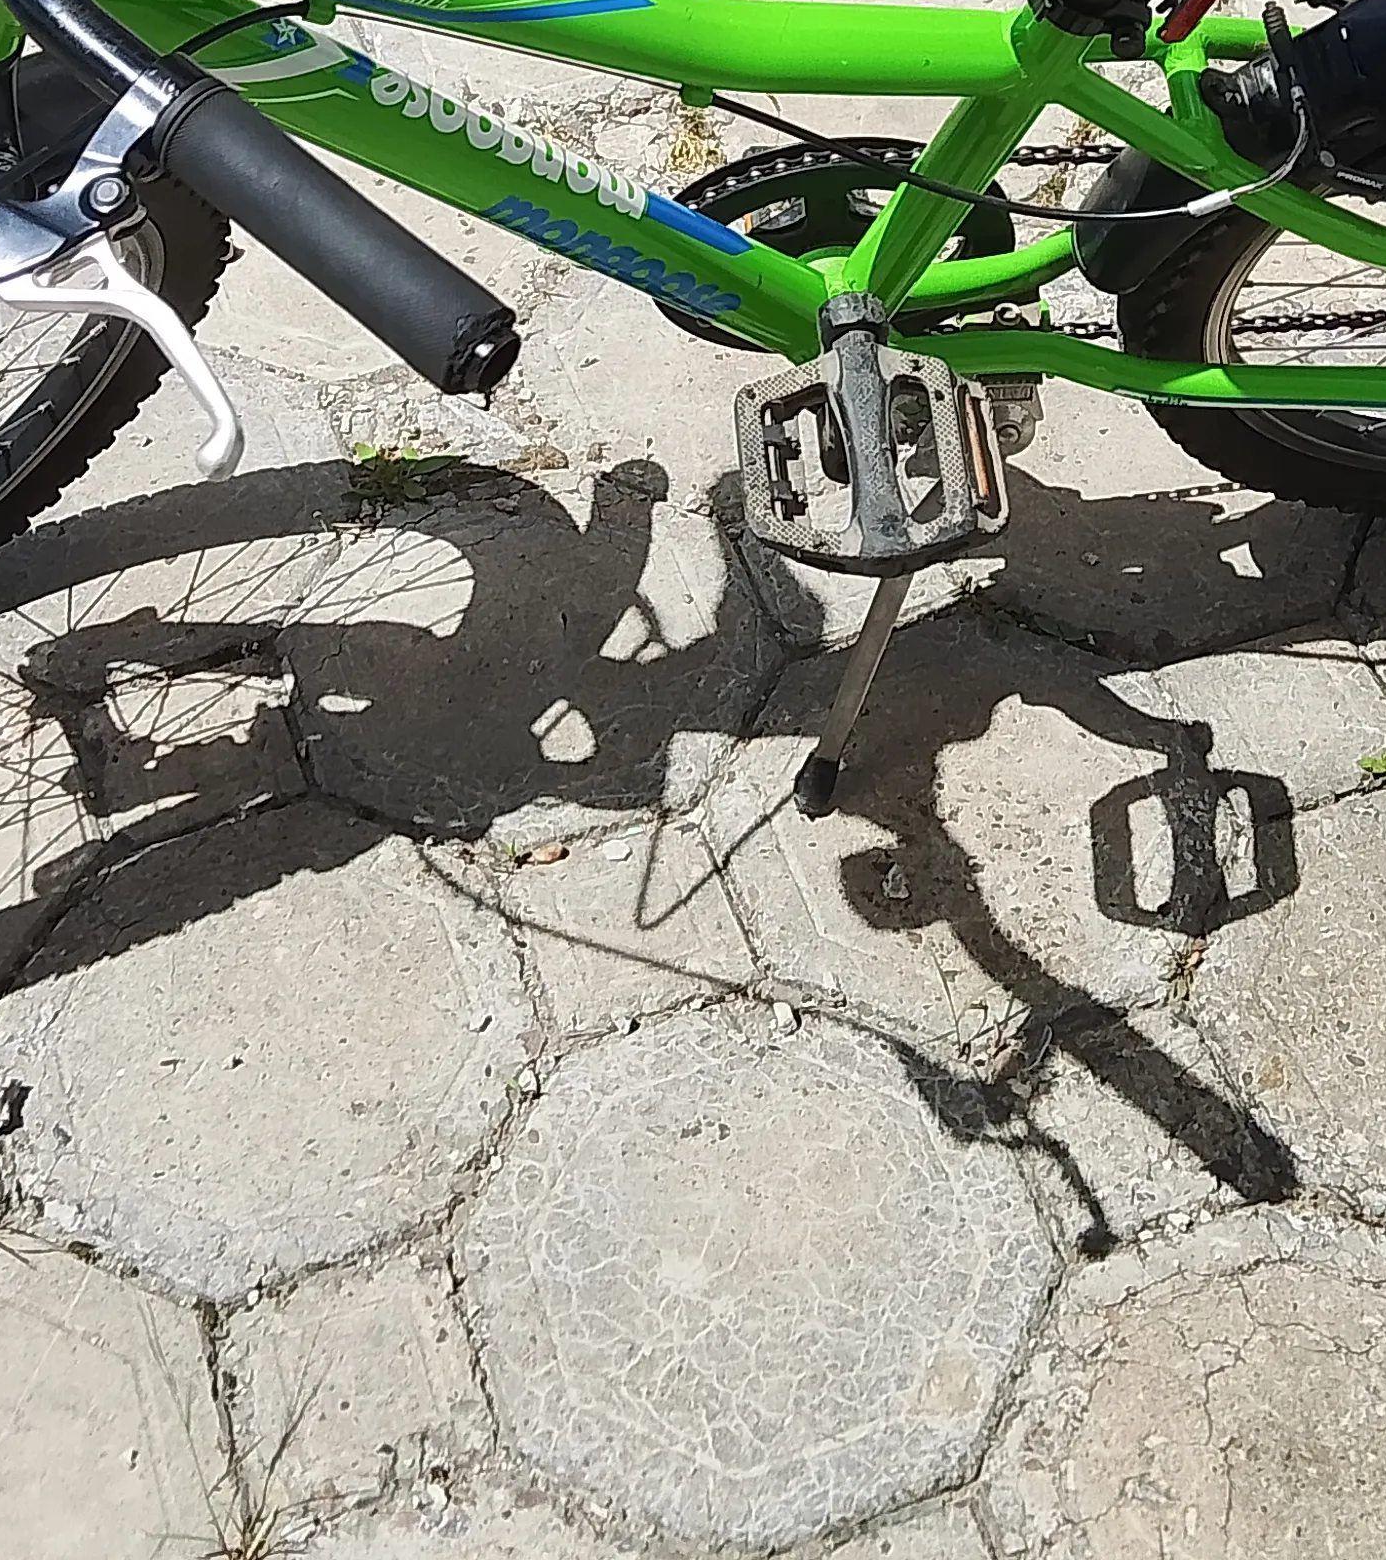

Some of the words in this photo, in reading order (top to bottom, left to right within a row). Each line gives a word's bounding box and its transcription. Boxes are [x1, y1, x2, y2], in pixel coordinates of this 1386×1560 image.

[370, 71, 649, 220] mongoose
[1335, 170, 1384, 190] PROMAX
[479, 194, 742, 316] mongoose
